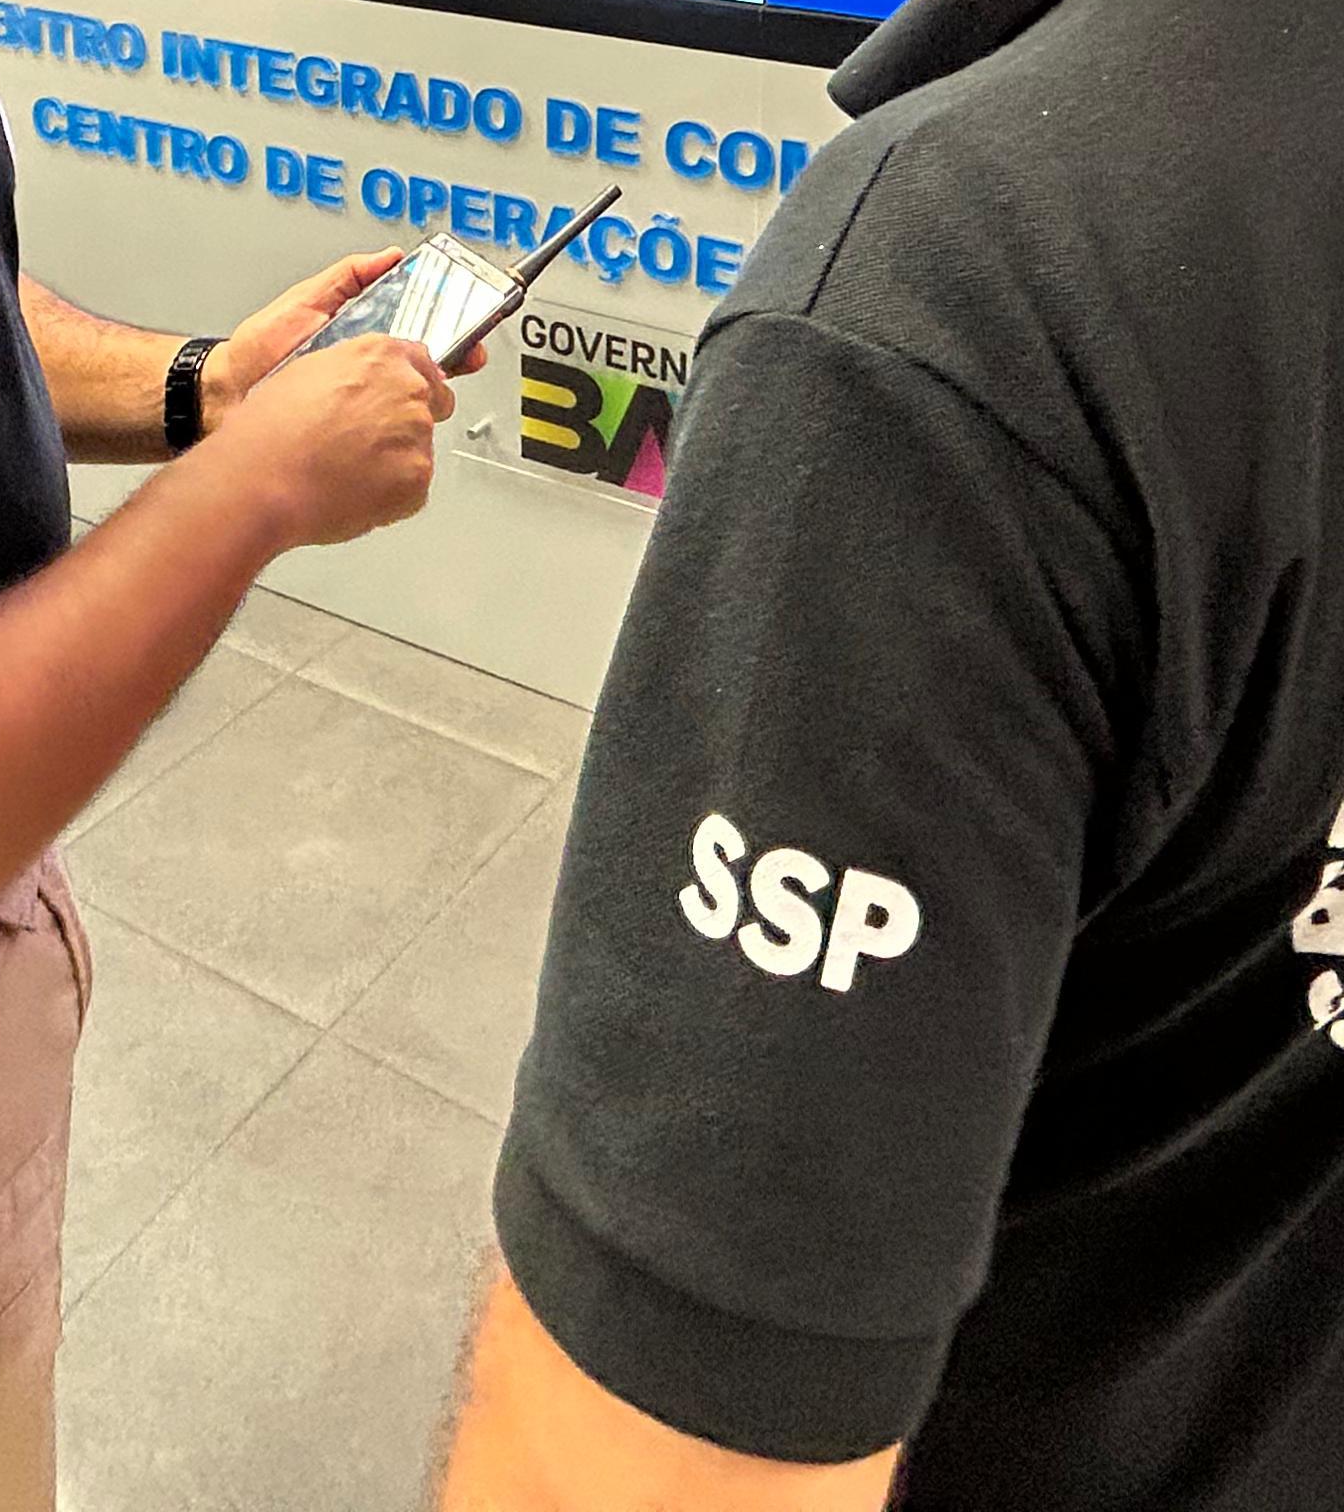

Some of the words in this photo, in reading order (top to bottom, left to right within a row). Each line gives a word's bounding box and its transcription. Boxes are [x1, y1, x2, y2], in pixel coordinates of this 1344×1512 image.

[32, 96, 249, 185] CENTRO
[264, 145, 344, 209] DE
[161, 30, 523, 144] INTEGRADO
[545, 96, 642, 167] DE
[678, 812, 921, 993] SSP
